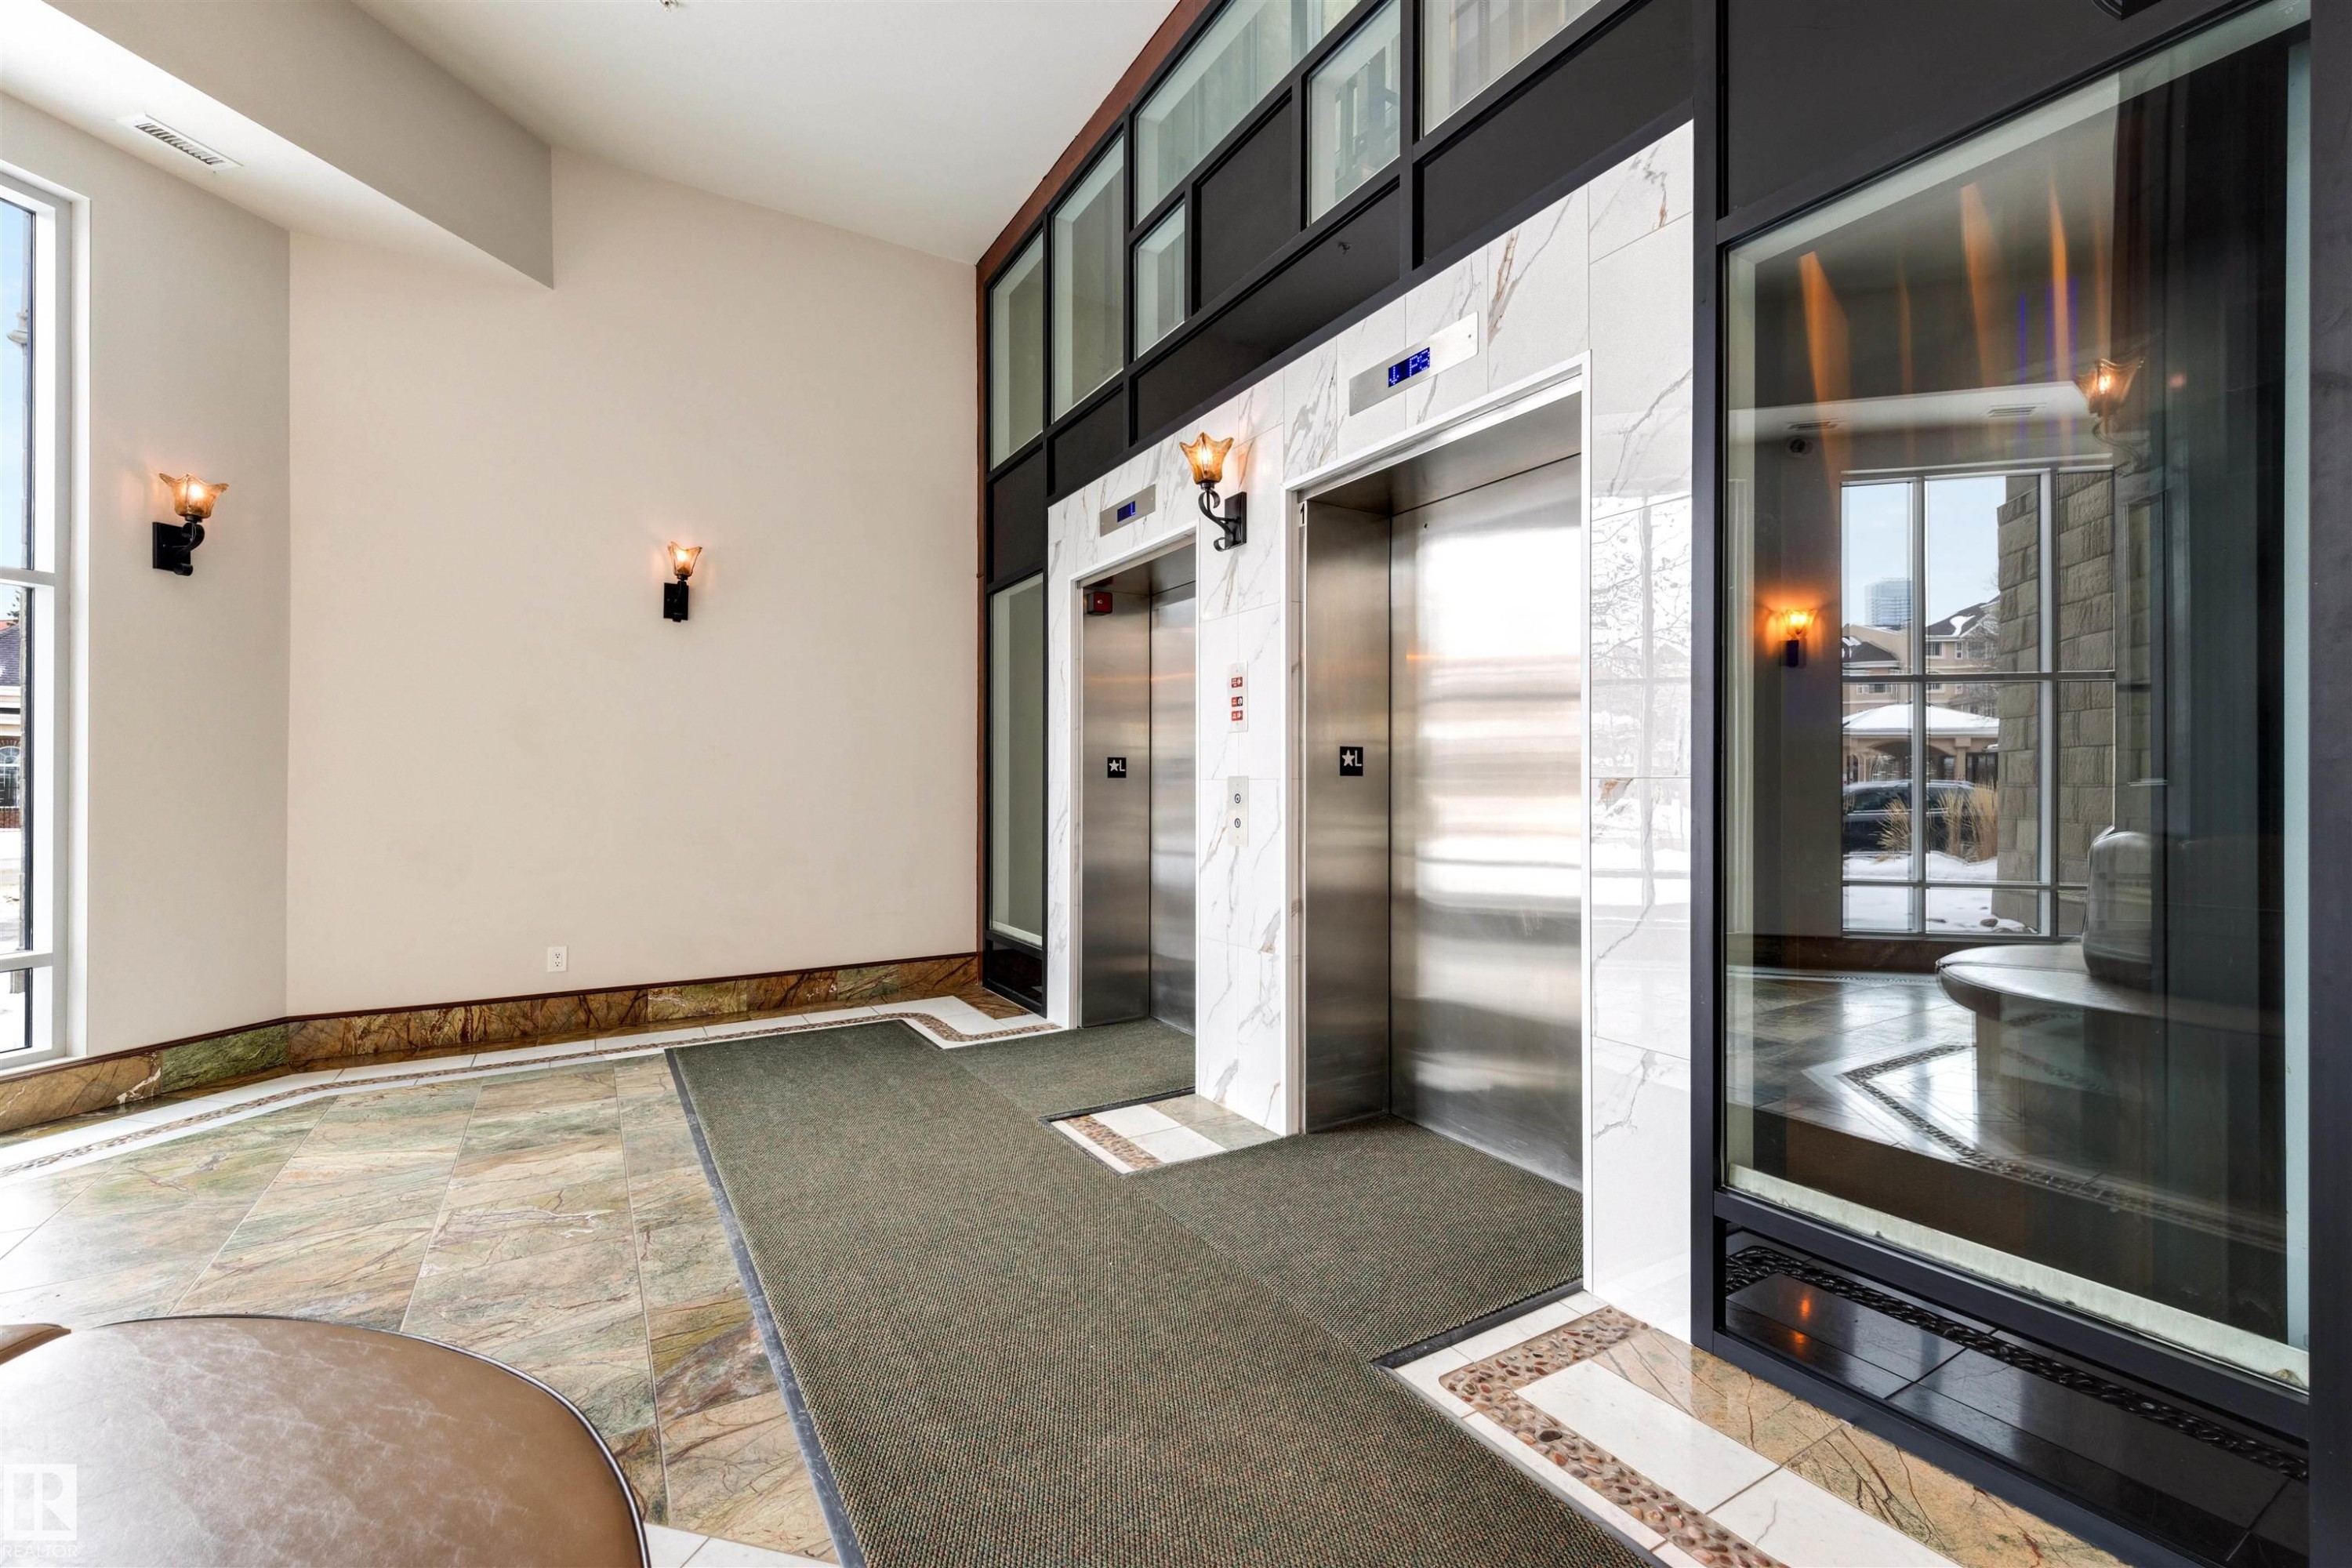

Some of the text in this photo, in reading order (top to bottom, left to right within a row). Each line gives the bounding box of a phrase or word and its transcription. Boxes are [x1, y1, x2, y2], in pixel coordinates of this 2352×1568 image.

[1300, 503, 1305, 524] 1
[1119, 759, 1126, 772] L
[1355, 750, 1363, 767] L
